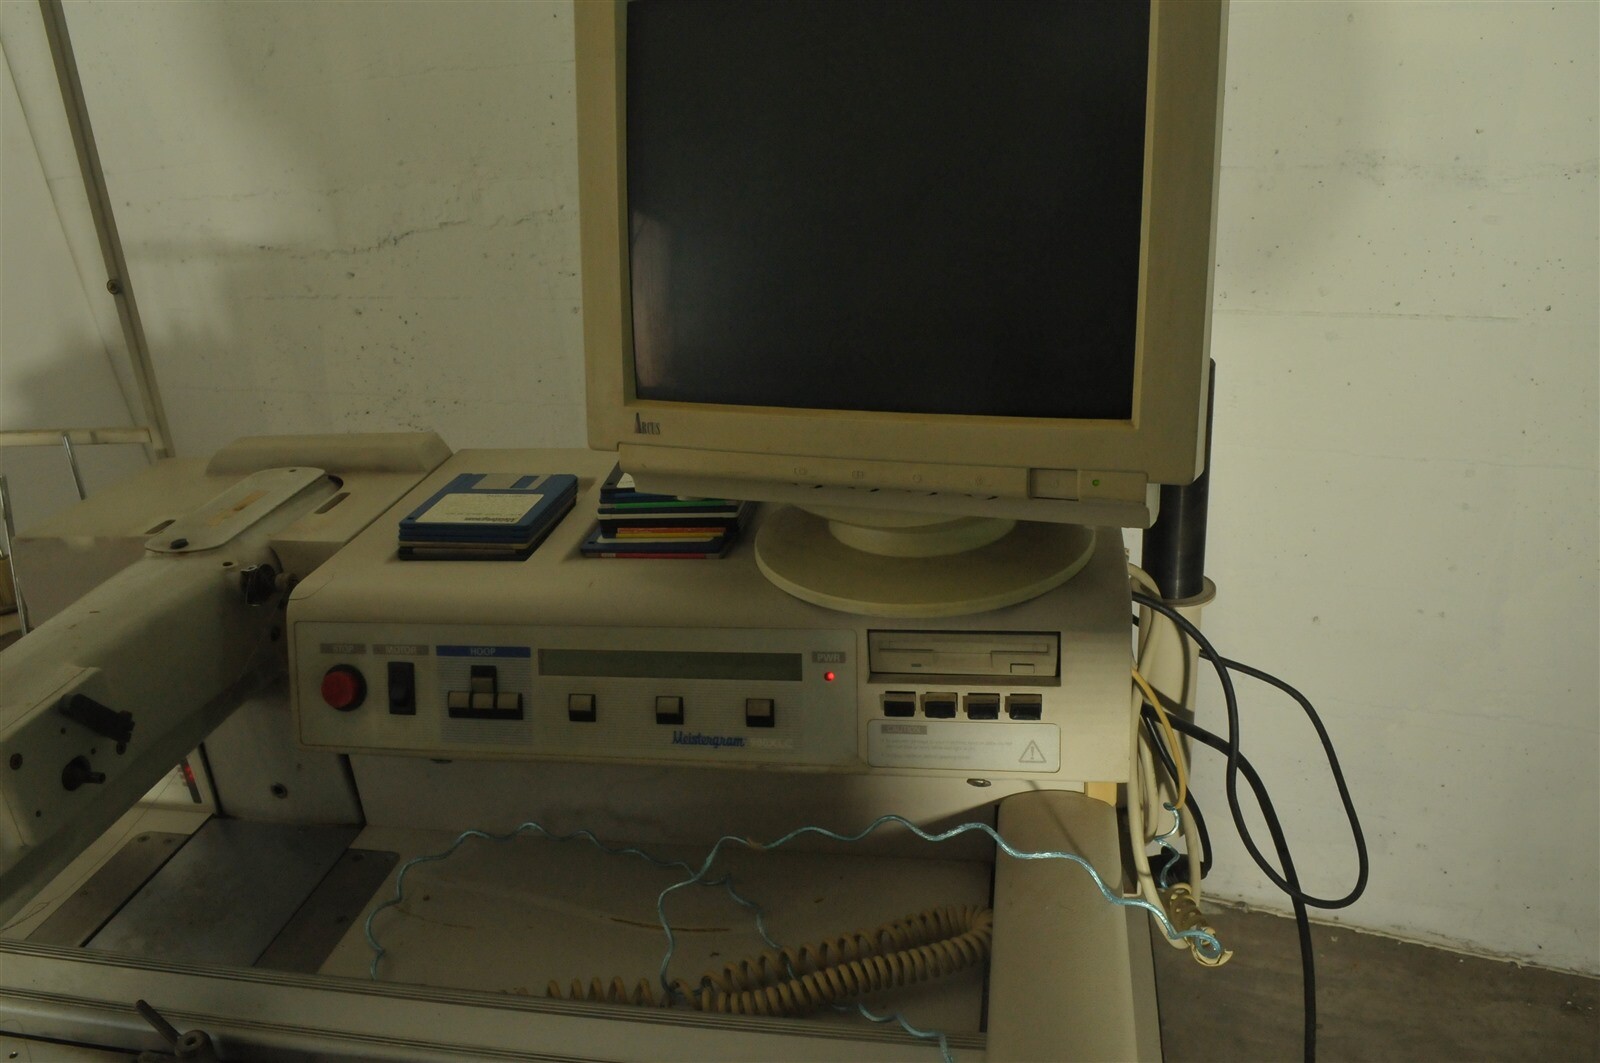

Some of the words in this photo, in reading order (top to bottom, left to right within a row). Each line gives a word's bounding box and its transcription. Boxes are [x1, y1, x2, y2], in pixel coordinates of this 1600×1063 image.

[333, 644, 354, 653] STOP
[385, 645, 417, 655] MOTOR
[469, 647, 496, 656] HOOP
[816, 653, 841, 662] PWR
[672, 731, 745, 748] Meistergram
